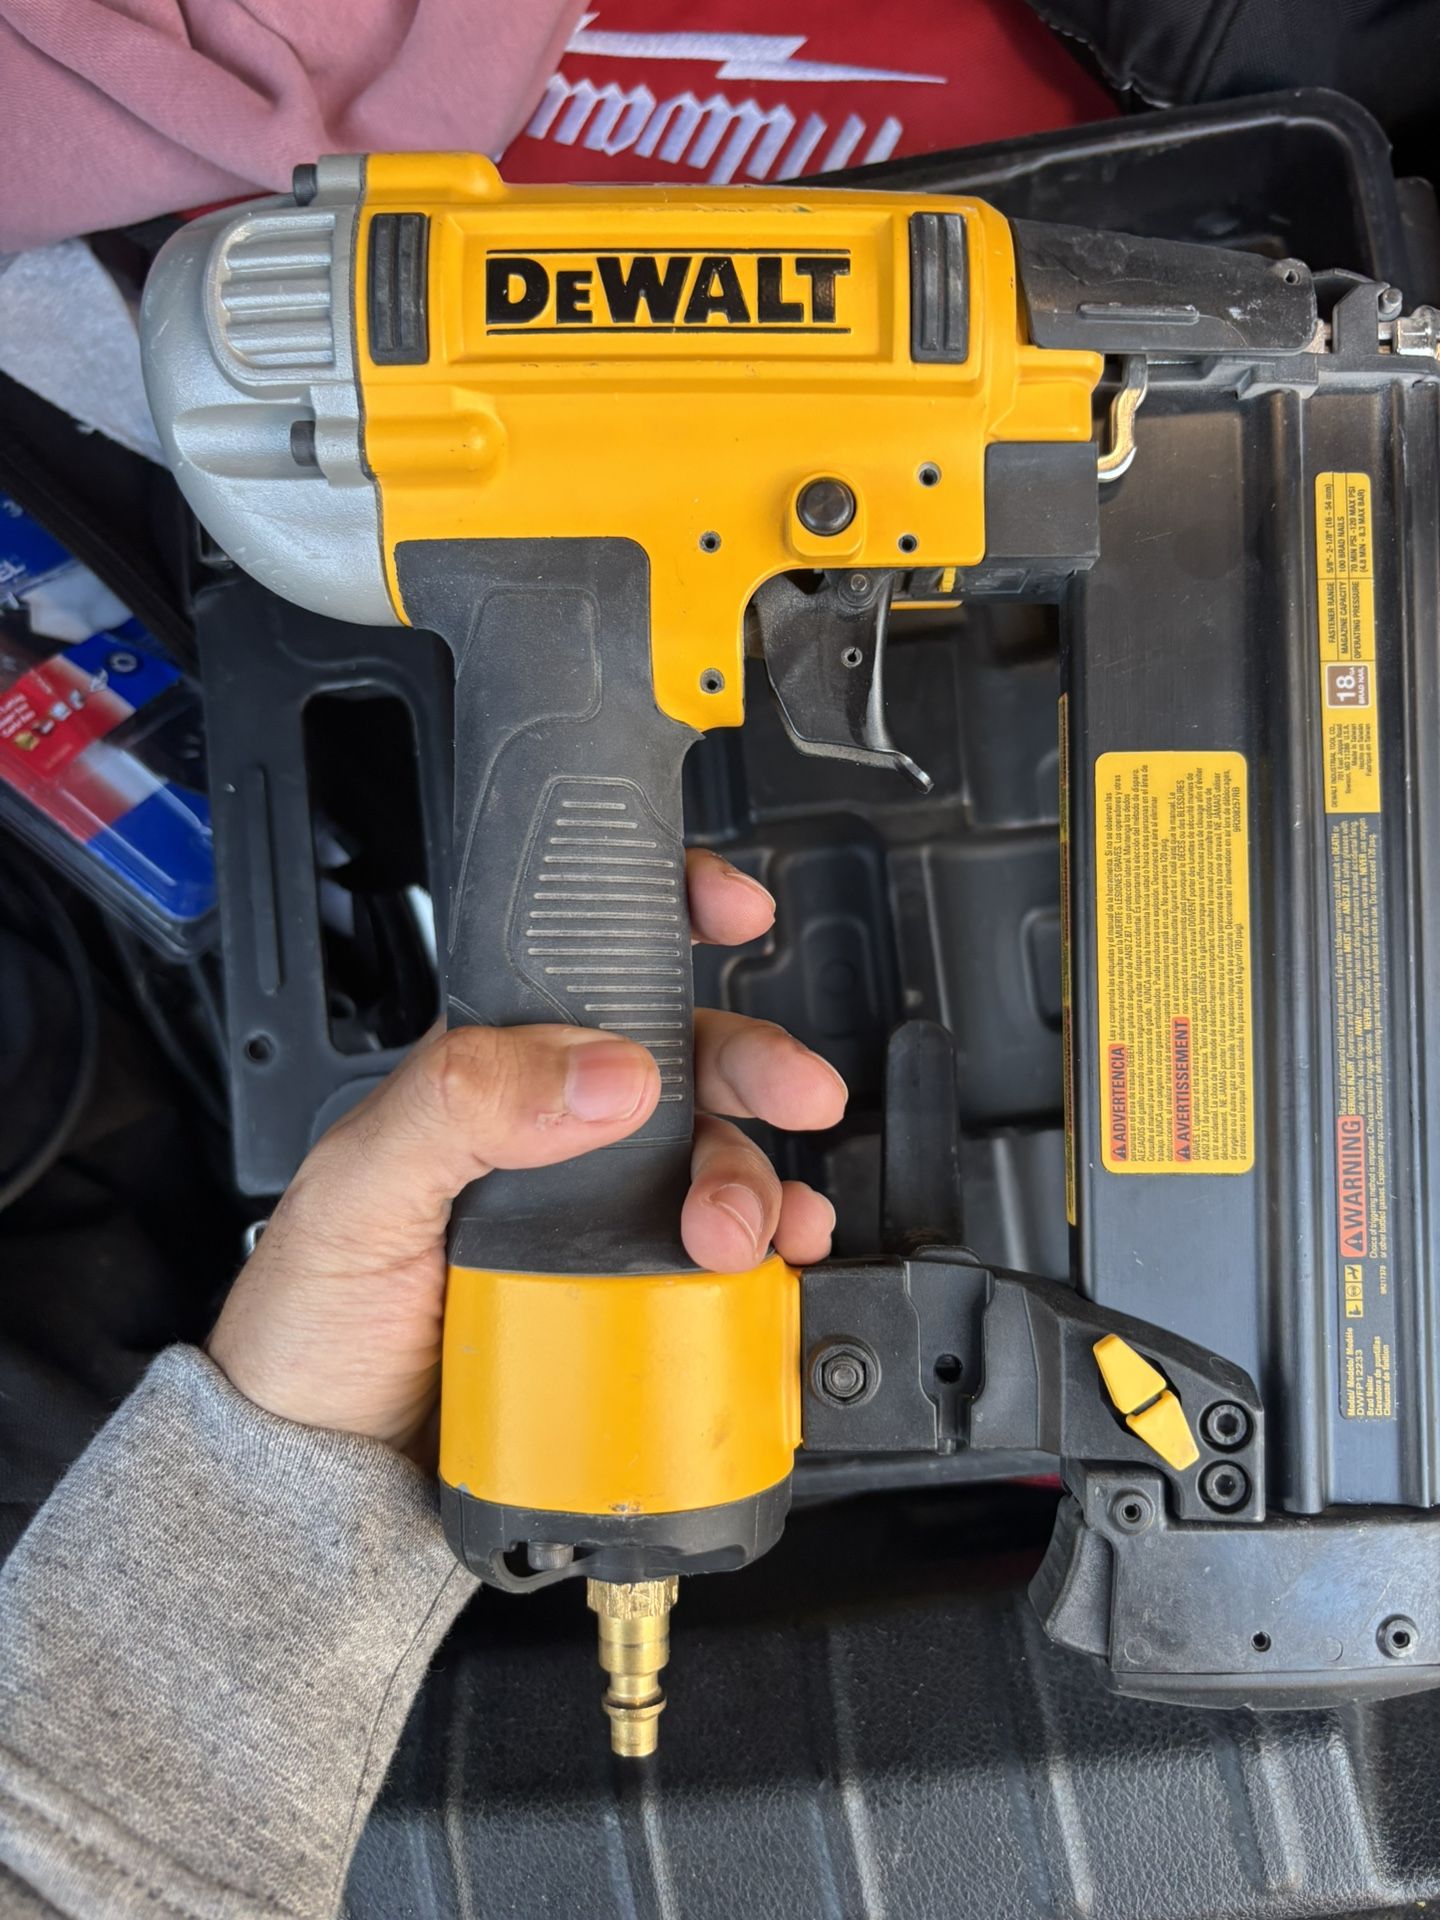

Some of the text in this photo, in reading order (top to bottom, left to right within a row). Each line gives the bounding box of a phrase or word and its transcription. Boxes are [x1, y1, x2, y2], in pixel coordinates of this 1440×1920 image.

[1327, 607, 1335, 642] FASTENER
[1339, 582, 1348, 653] MAGAZINE CAPACITY
[1353, 619, 1361, 657] OPERATING
[1335, 675, 1356, 702] 18
[1111, 1047, 1125, 1141] ADVERTENCIA
[1174, 1020, 1189, 1141] AVERTISSEMENT
[1341, 1120, 1362, 1230] WARNING
[1355, 1349, 1364, 1415] DWFP12233
[1365, 1375, 1373, 1396] Nailer
